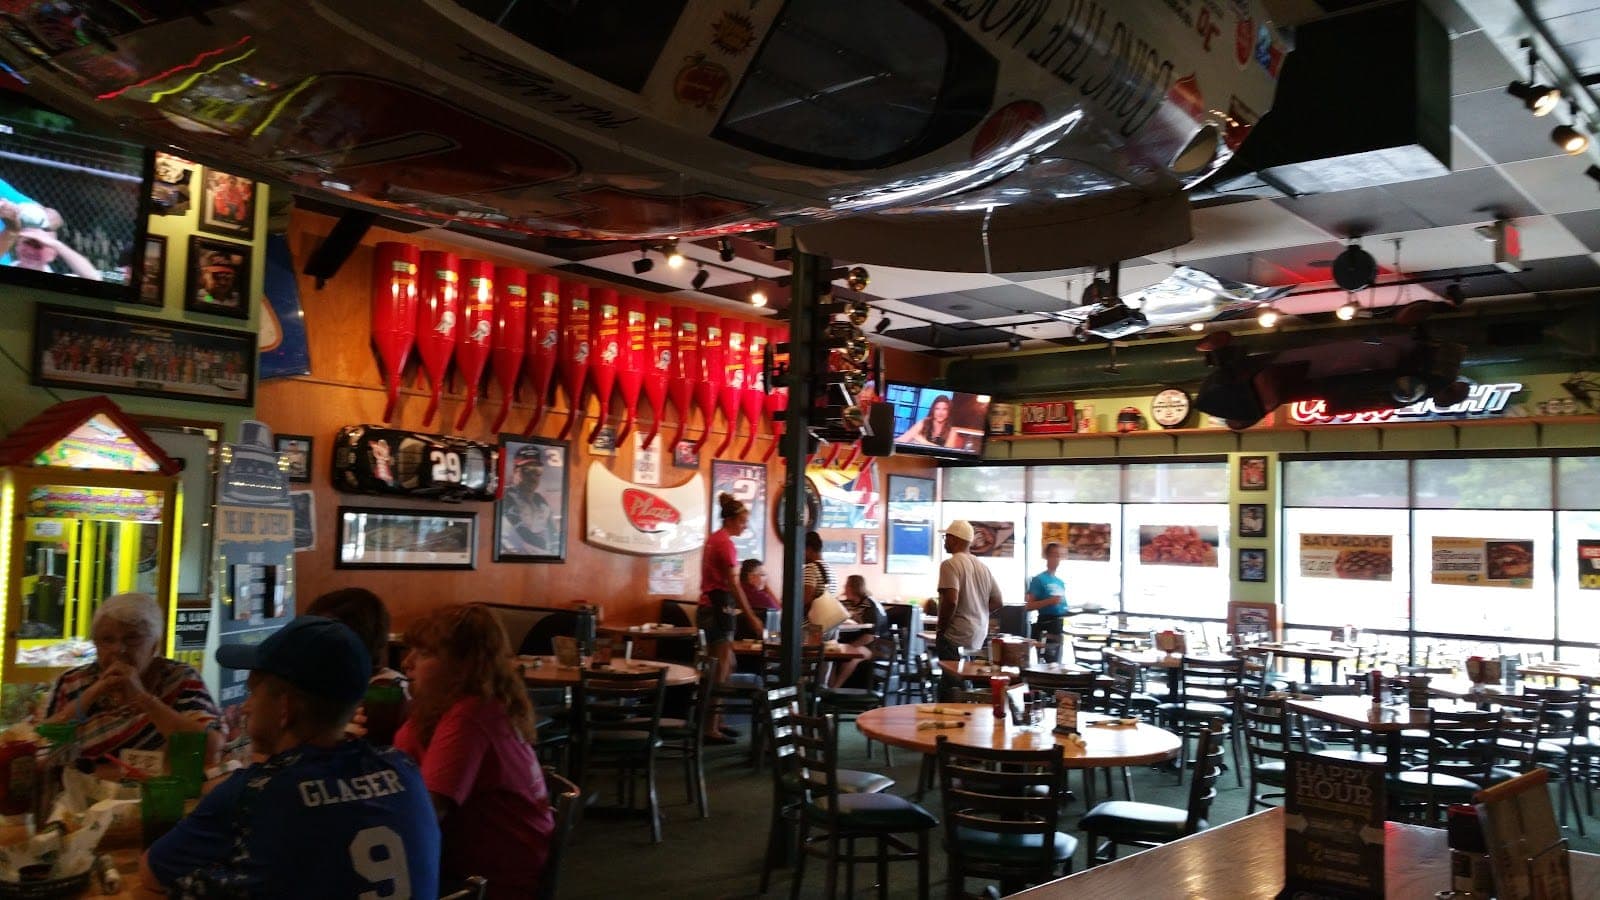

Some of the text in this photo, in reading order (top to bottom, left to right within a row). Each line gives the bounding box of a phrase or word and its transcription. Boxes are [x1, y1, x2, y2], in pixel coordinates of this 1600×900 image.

[430, 450, 462, 483] 29
[1303, 535, 1391, 549] SATURDAYS
[299, 769, 406, 807] GLASER
[1295, 760, 1375, 786] HAPPY
[1296, 776, 1374, 805] HOUR
[349, 825, 411, 900] 9
